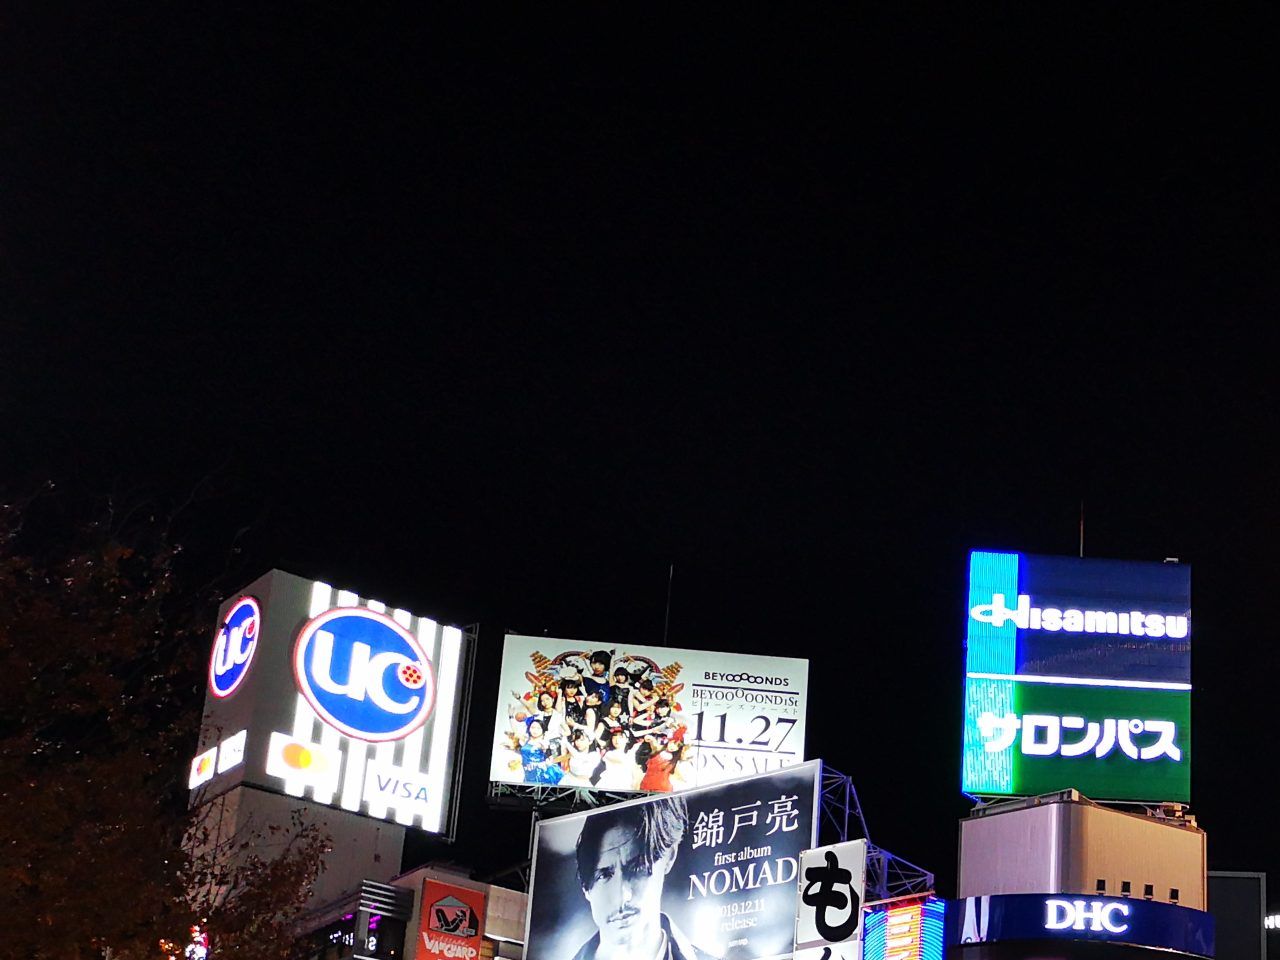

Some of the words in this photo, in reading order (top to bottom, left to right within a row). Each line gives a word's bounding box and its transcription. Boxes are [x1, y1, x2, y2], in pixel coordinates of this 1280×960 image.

[312, 631, 421, 714] UC
[691, 711, 798, 752] 11.27
[978, 712, 1181, 762] サロンパス
[377, 774, 429, 802] VISA
[691, 795, 799, 850] 錦戸亮
[714, 851, 737, 865] first
[737, 845, 772, 861] album
[687, 856, 798, 901] NOMAD
[714, 898, 766, 918] 019.12.11
[1045, 899, 1130, 933] DHC
